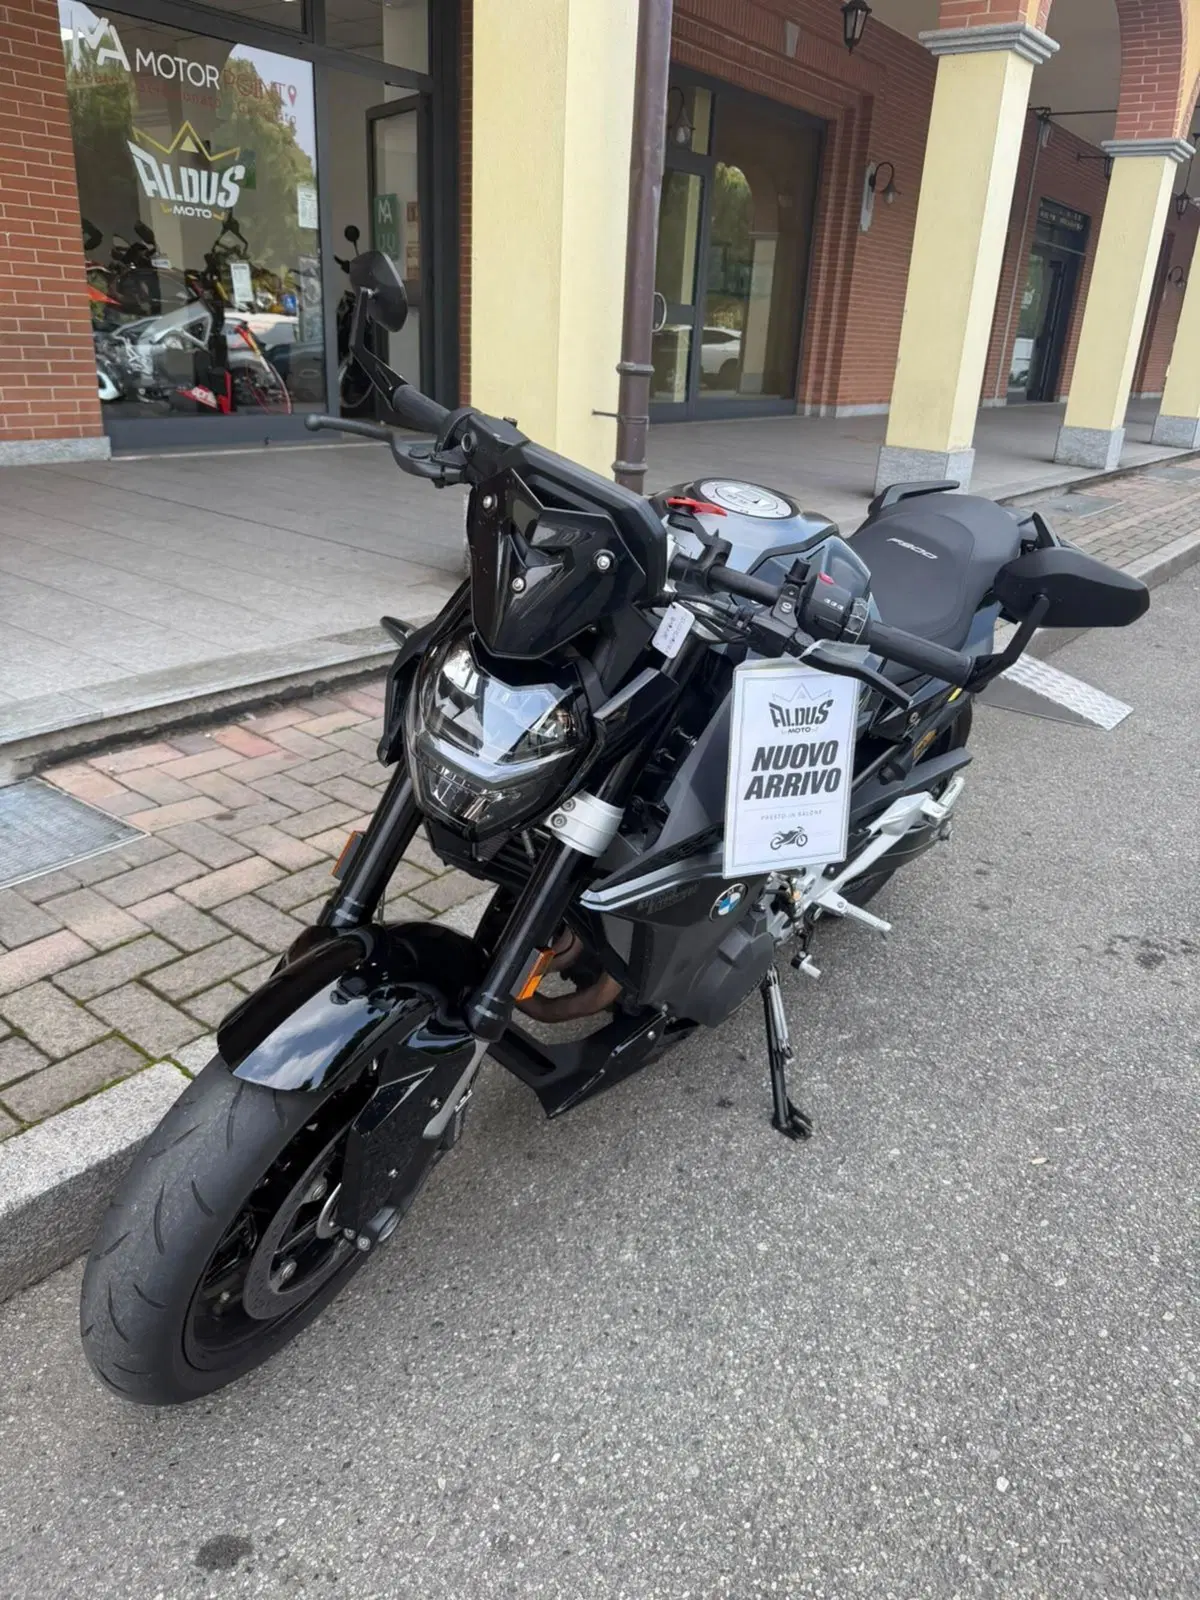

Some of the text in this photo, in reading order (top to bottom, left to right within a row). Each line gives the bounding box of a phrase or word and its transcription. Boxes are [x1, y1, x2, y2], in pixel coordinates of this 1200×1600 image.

[127, 140, 246, 208] ALDUS
[173, 205, 212, 219] MOTO
[769, 699, 834, 727] ALDUS
[751, 740, 839, 771] NUOVO
[743, 768, 841, 800] ARRIVO
